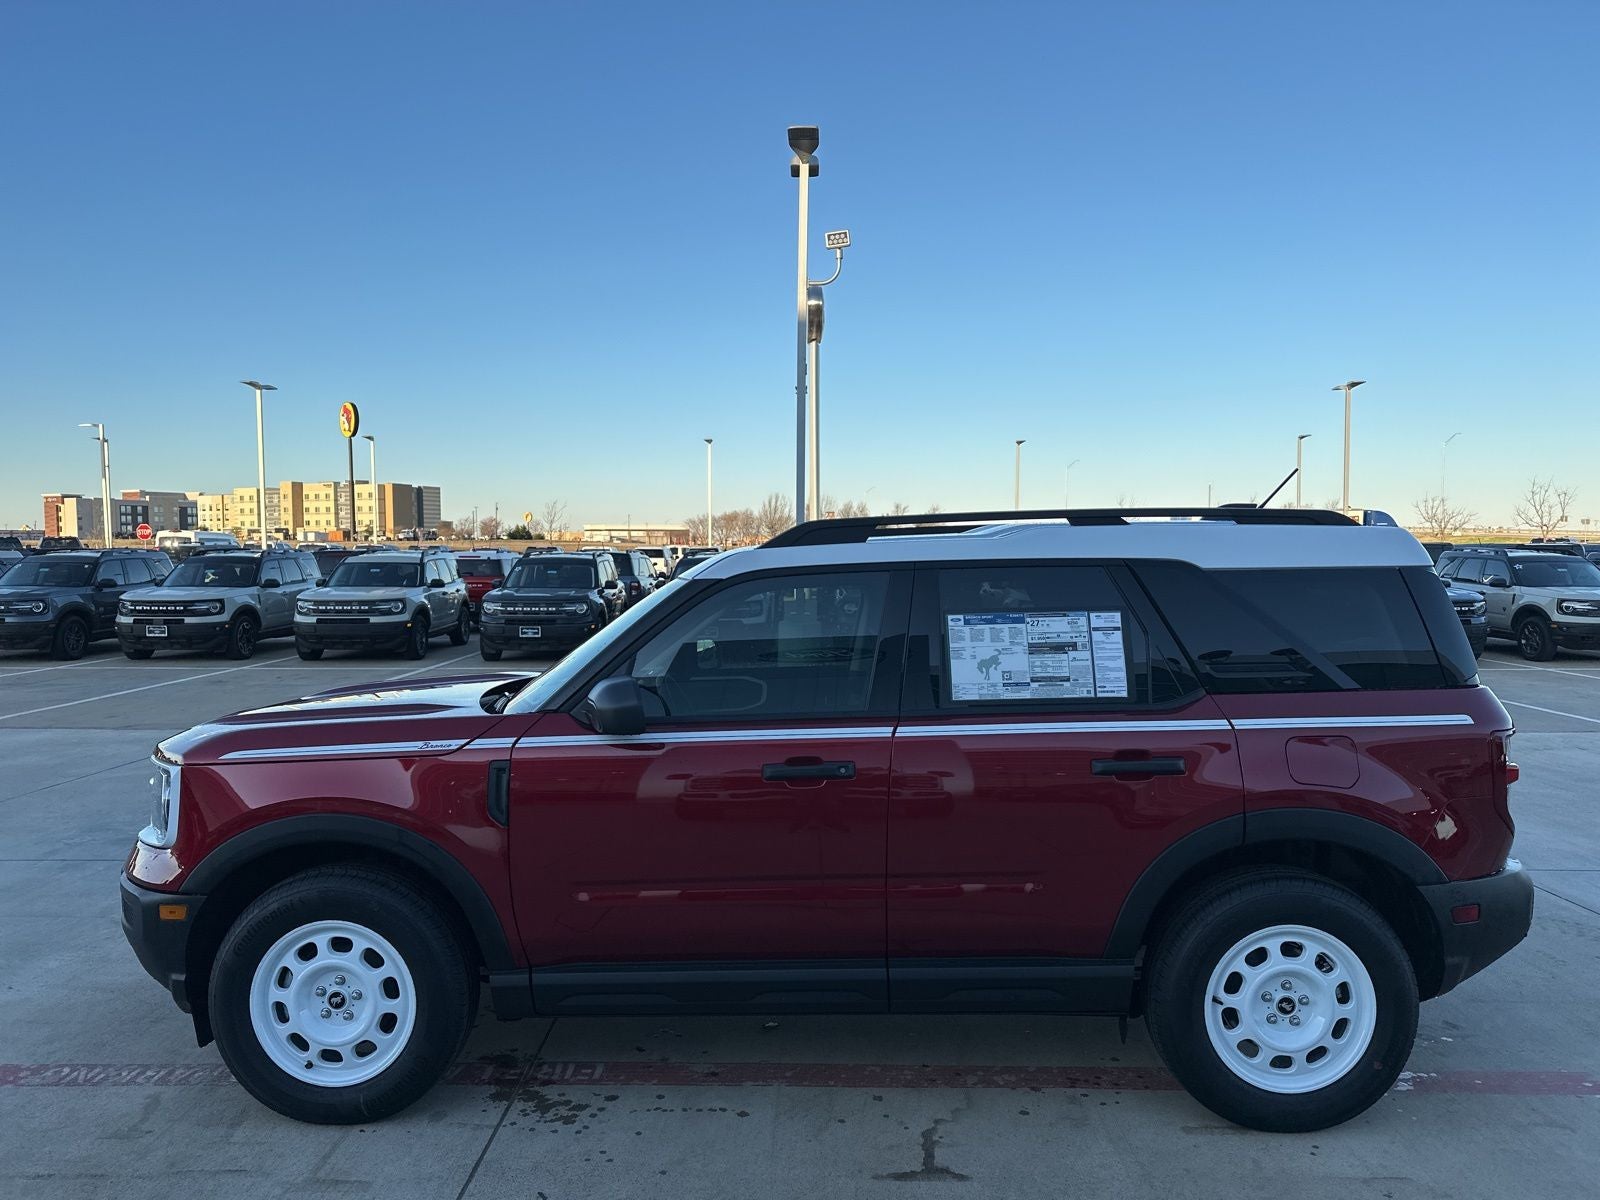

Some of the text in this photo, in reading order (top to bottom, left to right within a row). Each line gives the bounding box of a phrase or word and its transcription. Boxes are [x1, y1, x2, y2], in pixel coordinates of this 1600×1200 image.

[137, 528, 151, 536] STOP
[1030, 619, 1040, 627] 27
[417, 741, 453, 750] Bronco
